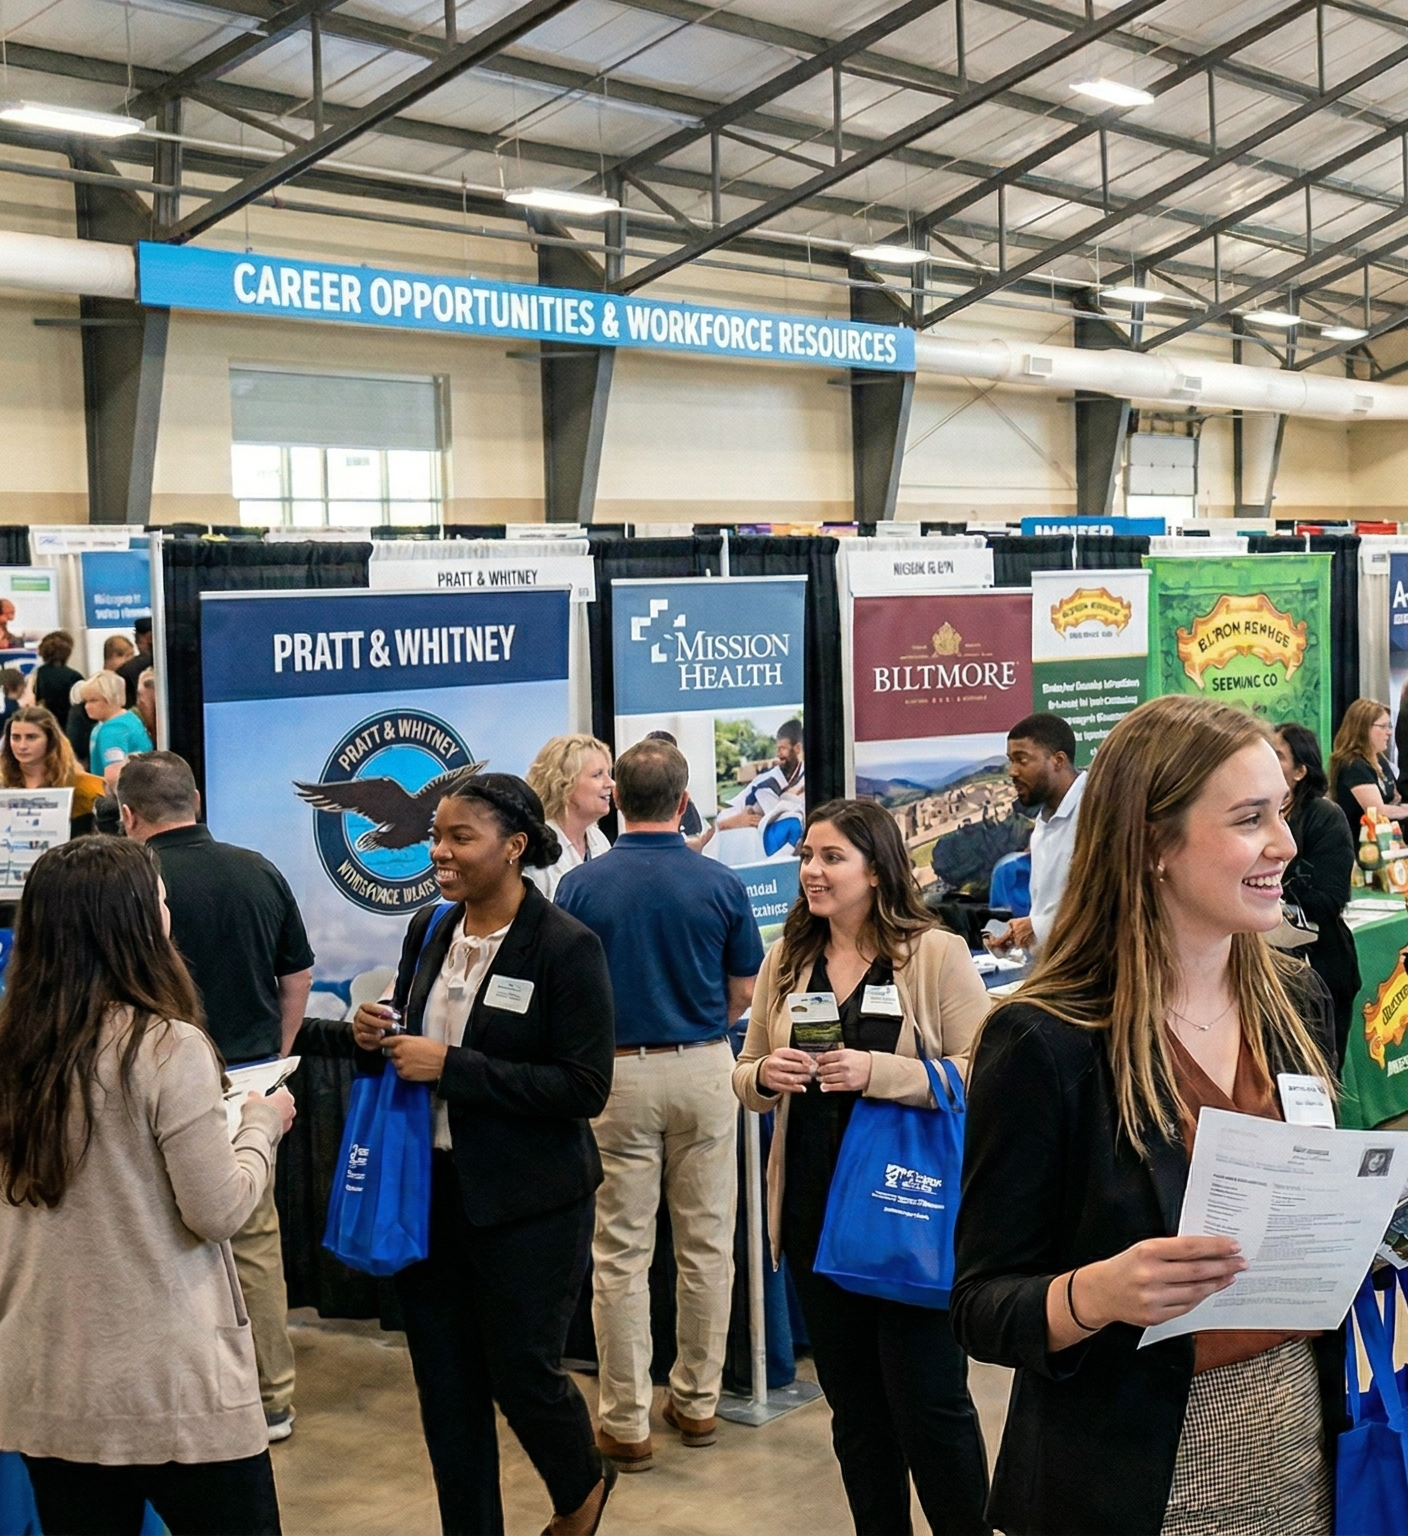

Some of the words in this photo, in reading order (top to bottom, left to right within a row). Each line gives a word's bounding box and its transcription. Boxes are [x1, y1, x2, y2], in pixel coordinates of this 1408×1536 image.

[233, 262, 362, 314] CAREER
[370, 276, 596, 336] OPPORTUNITIES
[602, 301, 620, 338] &
[626, 305, 773, 352] WORKFORCE
[779, 320, 897, 364] RESOURCES
[437, 571, 473, 587] PRATT
[477, 571, 485, 586] &
[488, 569, 538, 586] WHITNEY
[273, 630, 365, 673] PRATT
[369, 628, 391, 668] &
[395, 624, 516, 666] WHITNEY
[873, 661, 1017, 692] BILTMORE
[1263, 673, 1278, 687] CO
[338, 724, 380, 772] PRATT
[383, 720, 396, 740] &
[398, 719, 460, 759] WHITNEY
